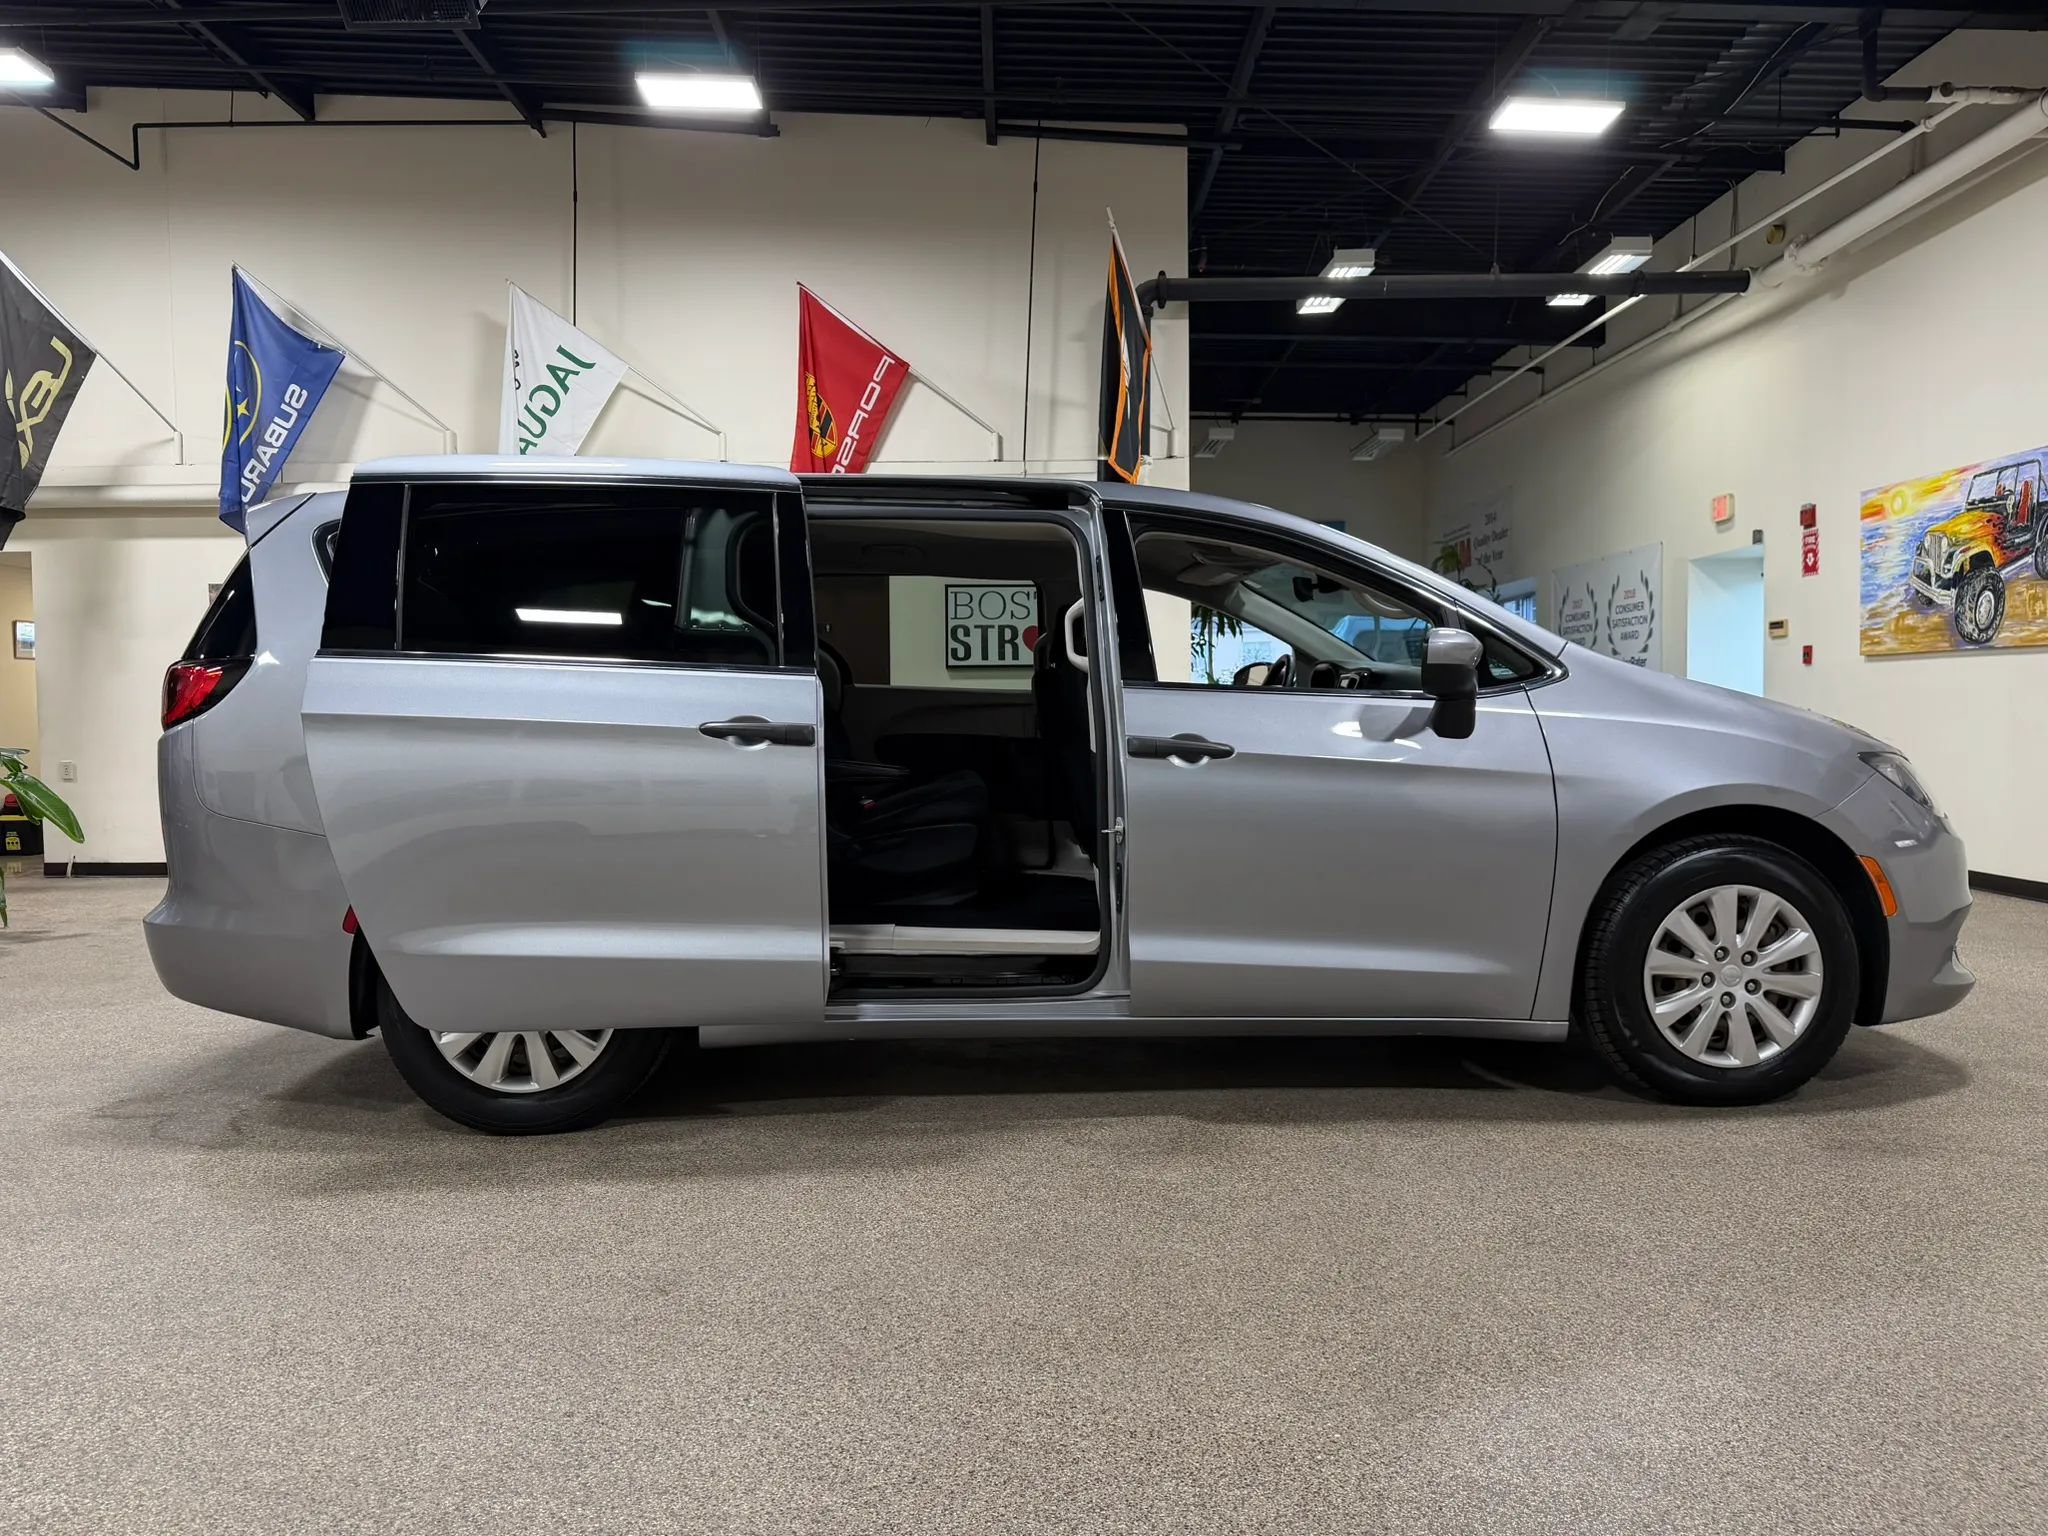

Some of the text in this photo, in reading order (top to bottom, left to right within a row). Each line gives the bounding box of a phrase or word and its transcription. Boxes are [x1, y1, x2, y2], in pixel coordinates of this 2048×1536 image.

[1615, 601, 1644, 615] CONSUMER
[1565, 610, 1590, 623] CONSUMER
[1612, 615, 1648, 629] SATISFACTION
[1563, 623, 1593, 635] SATISFACTION
[1620, 630, 1639, 641] AWARD
